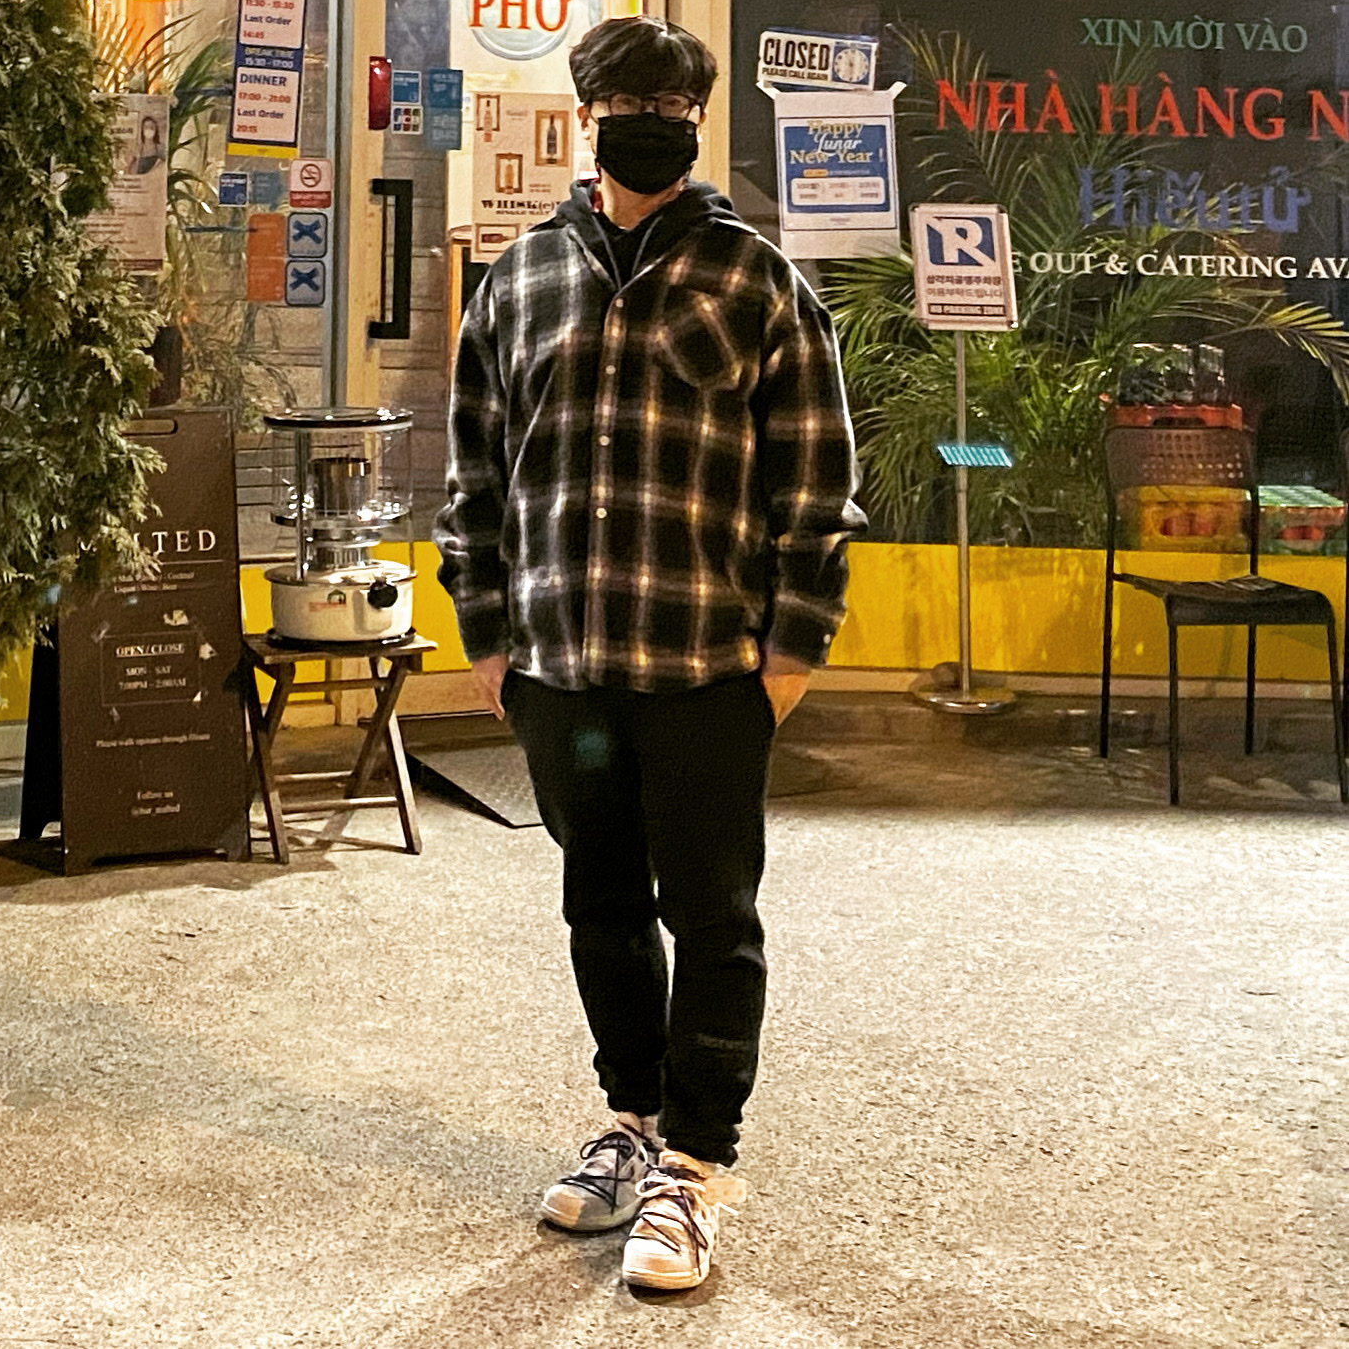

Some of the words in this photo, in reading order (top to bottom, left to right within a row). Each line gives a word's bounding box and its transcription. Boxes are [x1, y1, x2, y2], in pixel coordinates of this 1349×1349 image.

[244, 13, 263, 24] Last
[266, 14, 292, 26] Order
[1080, 18, 1141, 47] XIN
[1154, 15, 1225, 50] MỜI
[1235, 17, 1309, 53] VÀO
[763, 38, 830, 71] CLOSED
[239, 73, 288, 87] DINNER
[762, 67, 787, 77] PLEASE
[789, 70, 805, 79] CALL
[807, 72, 829, 81] AGAIN
[936, 69, 1078, 135] NHÀ
[1097, 71, 1286, 142] HÀNG
[806, 120, 864, 139] Happy
[813, 133, 863, 156] Lunar
[790, 149, 830, 165] New
[836, 149, 874, 164] Year
[1029, 253, 1098, 275] OUT
[1105, 253, 1129, 276] &
[1136, 254, 1297, 279] CATERING
[1306, 256, 1349, 280] AV
